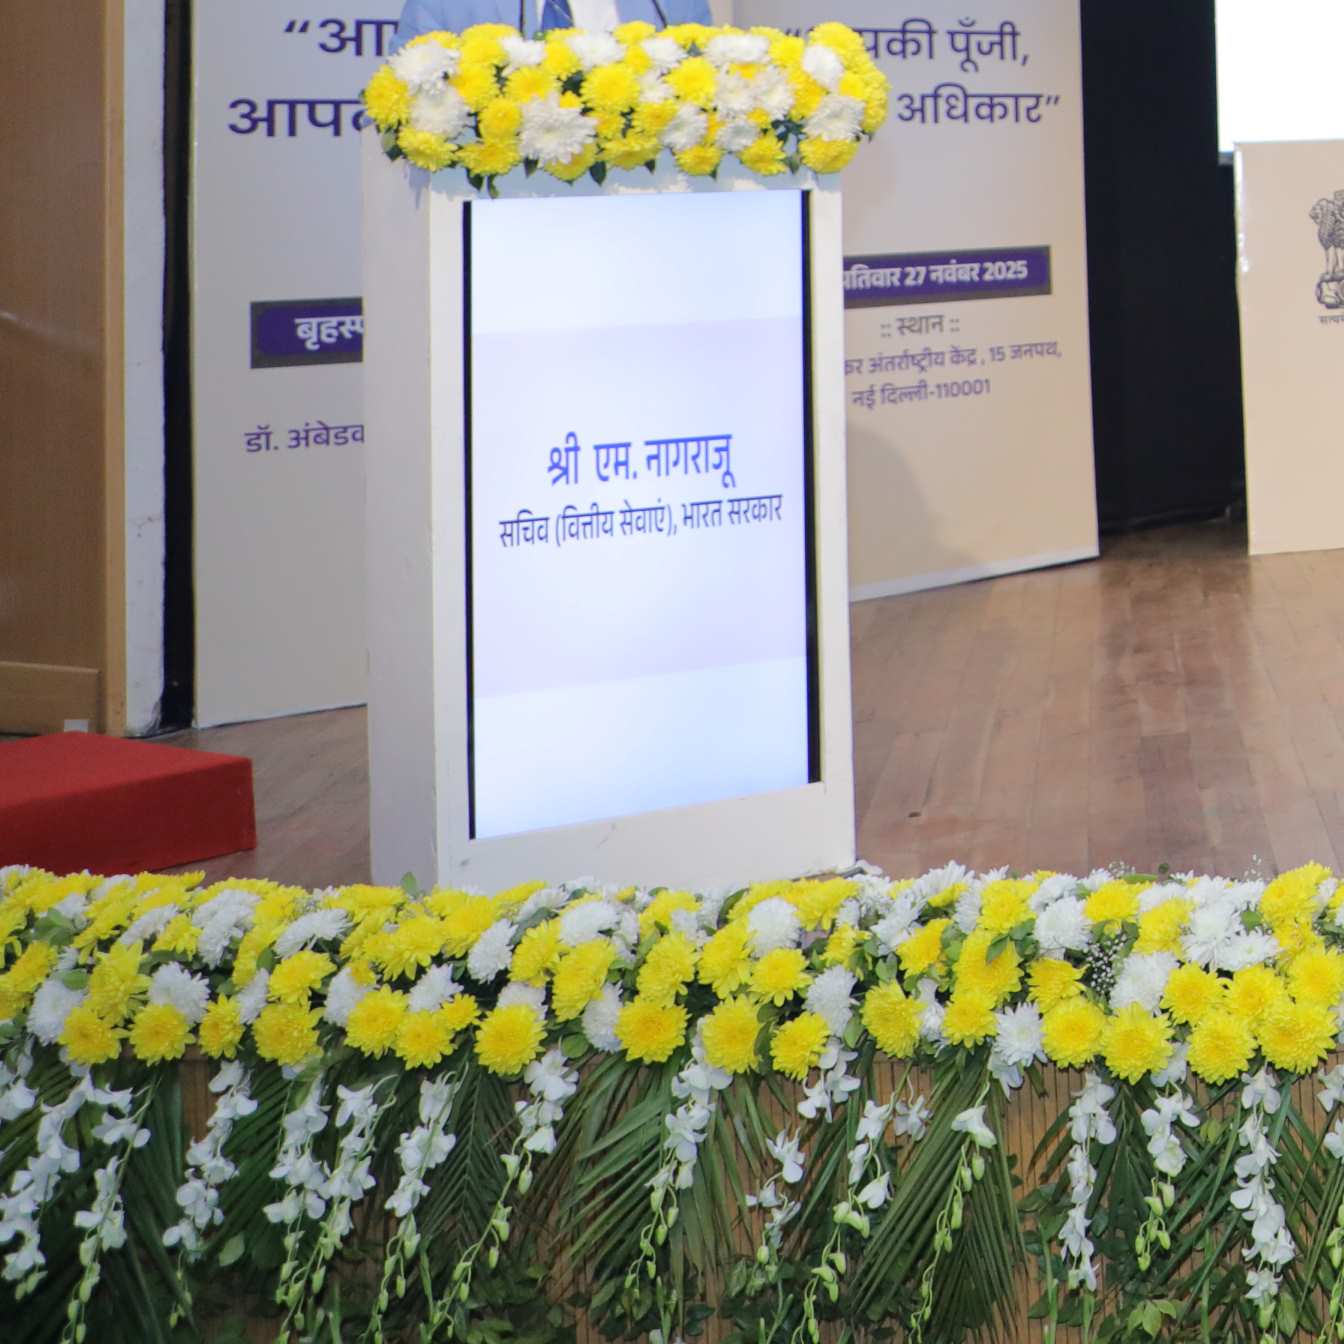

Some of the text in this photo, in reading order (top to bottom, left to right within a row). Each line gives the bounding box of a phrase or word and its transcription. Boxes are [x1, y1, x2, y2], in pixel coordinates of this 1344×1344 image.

[948, 17, 1030, 72] पूँजी,
[897, 83, 1059, 124] अधिकार”
[904, 267, 926, 286] 27
[930, 260, 980, 284] नवंबर
[982, 261, 1028, 281] 2025
[896, 314, 945, 338] स्थान
[546, 432, 737, 488] श्री एम. नागराजू
[499, 492, 784, 548] सचिव (वित्तीय सेवाएं), भारत सरकार
